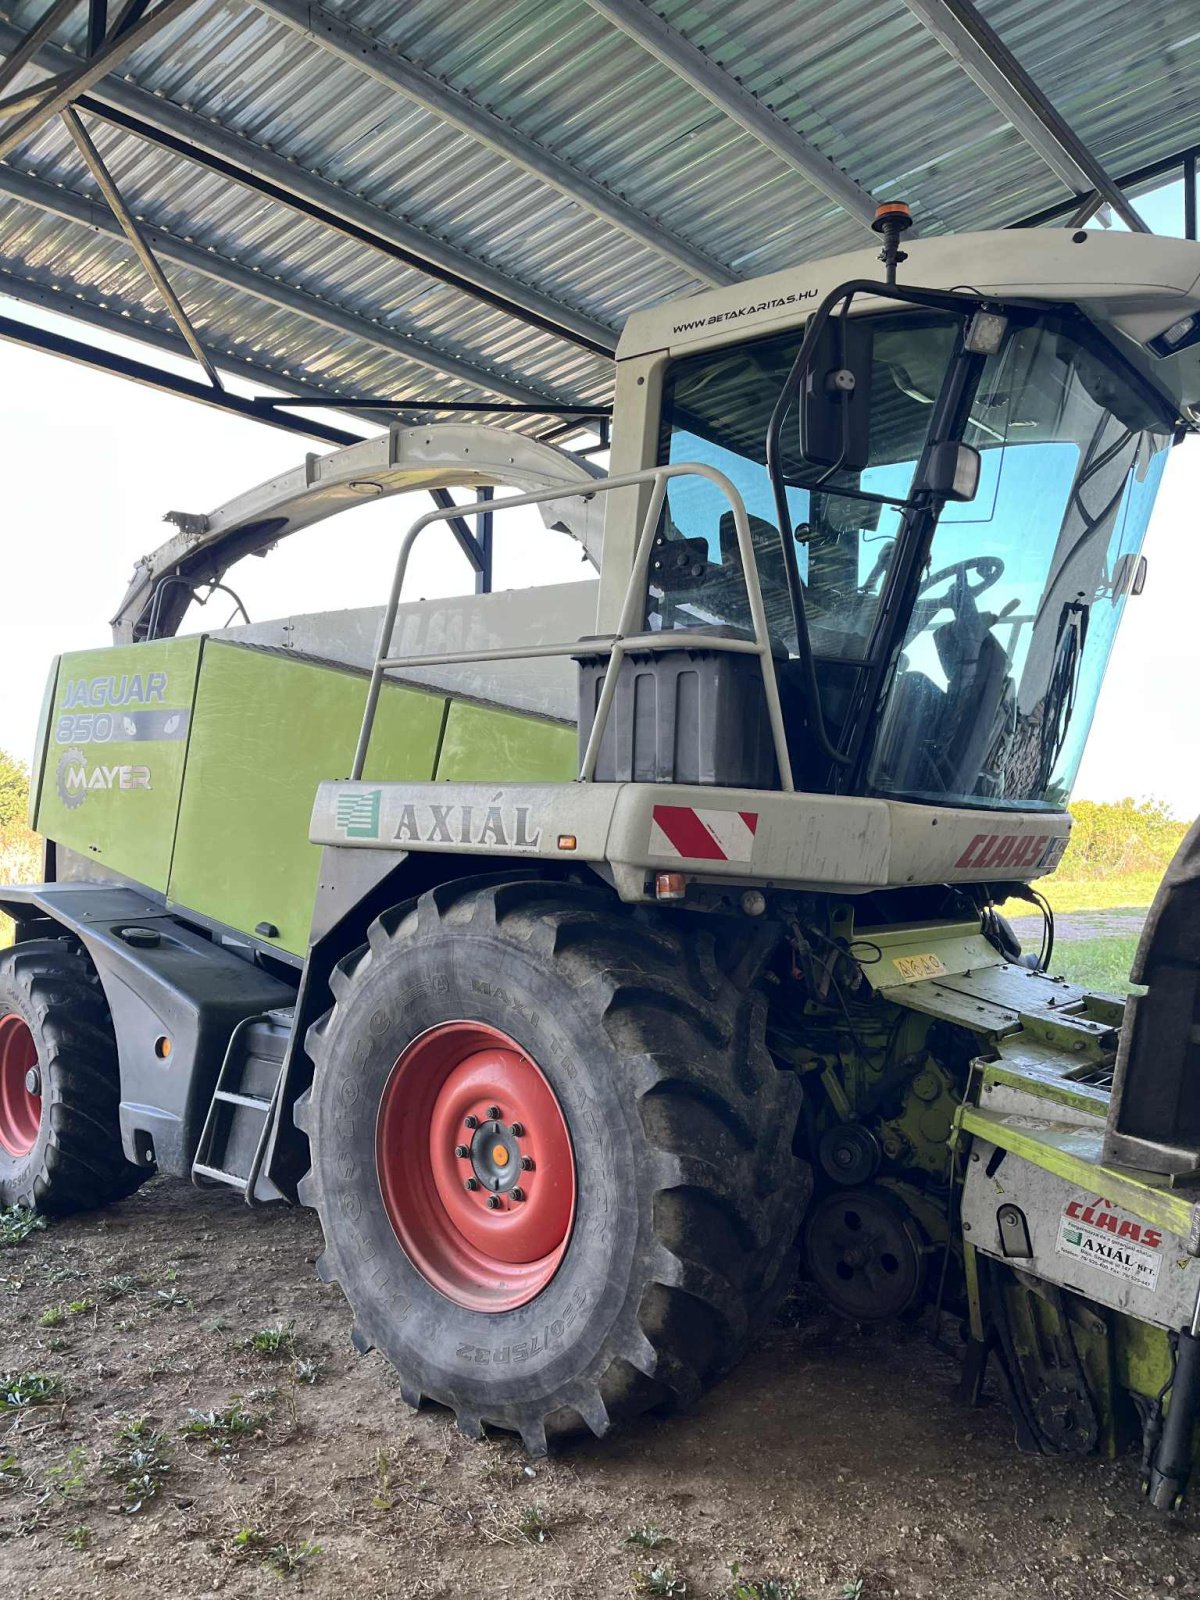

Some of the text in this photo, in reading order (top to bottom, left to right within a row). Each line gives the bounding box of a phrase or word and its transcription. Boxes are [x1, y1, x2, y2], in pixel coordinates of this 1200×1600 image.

[672, 288, 819, 334] WWW.BETAKARITAS.HU
[59, 672, 169, 710] JAGUAR
[56, 712, 114, 745] 850
[65, 764, 153, 791] MAYER
[393, 790, 541, 848] AXIÁL
[954, 833, 1050, 869] CLAAS
[1065, 1201, 1162, 1248] CLAAS
[1083, 1239, 1138, 1267] AXIÁL
